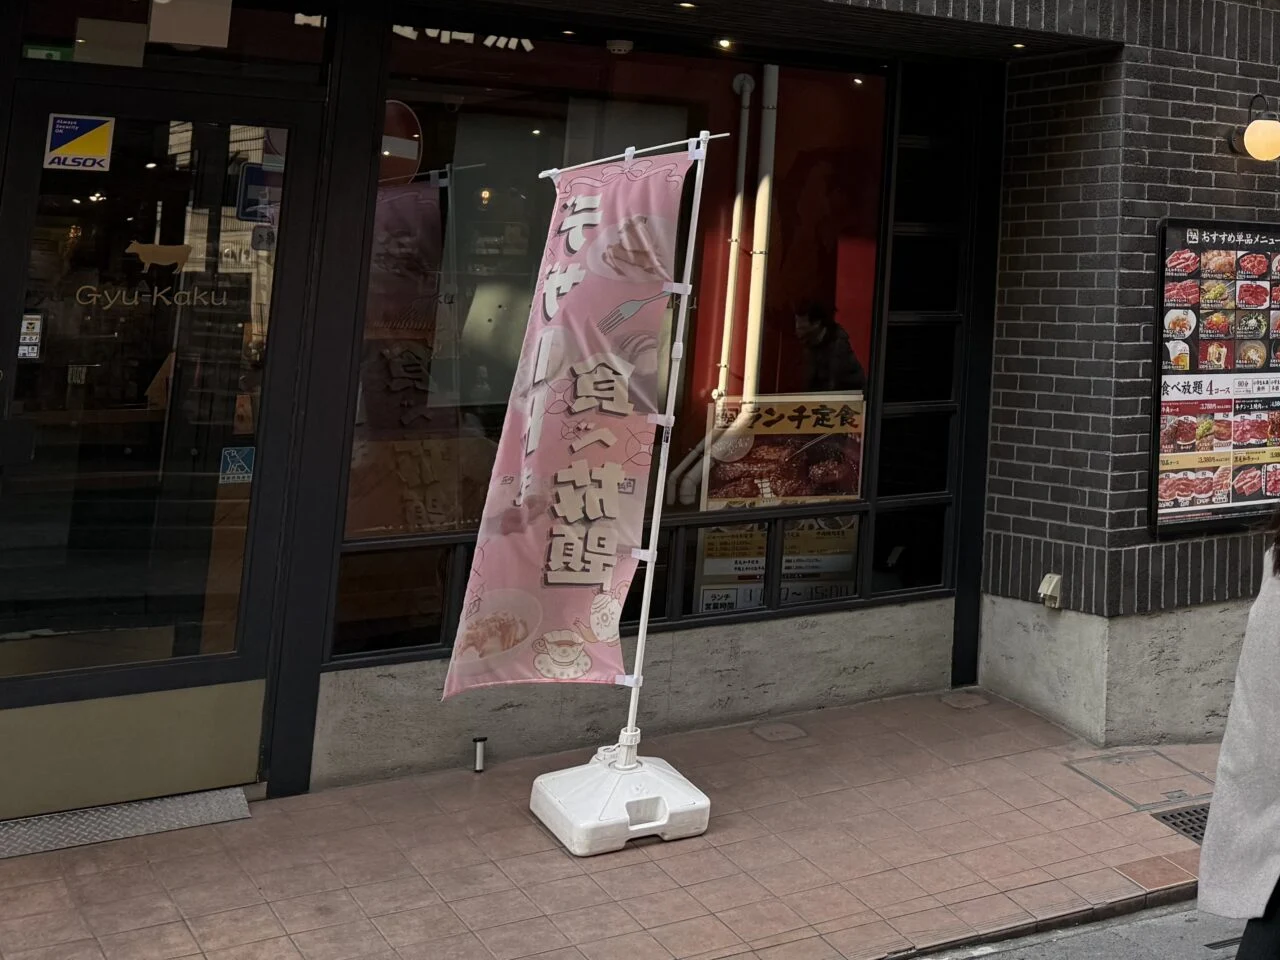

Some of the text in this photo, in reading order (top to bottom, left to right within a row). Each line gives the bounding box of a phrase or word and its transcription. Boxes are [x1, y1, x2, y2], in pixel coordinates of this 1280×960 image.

[48, 156, 105, 168] ALSOK
[75, 285, 228, 310] Gyu-Kaku
[1161, 379, 1203, 396] 食べ放題
